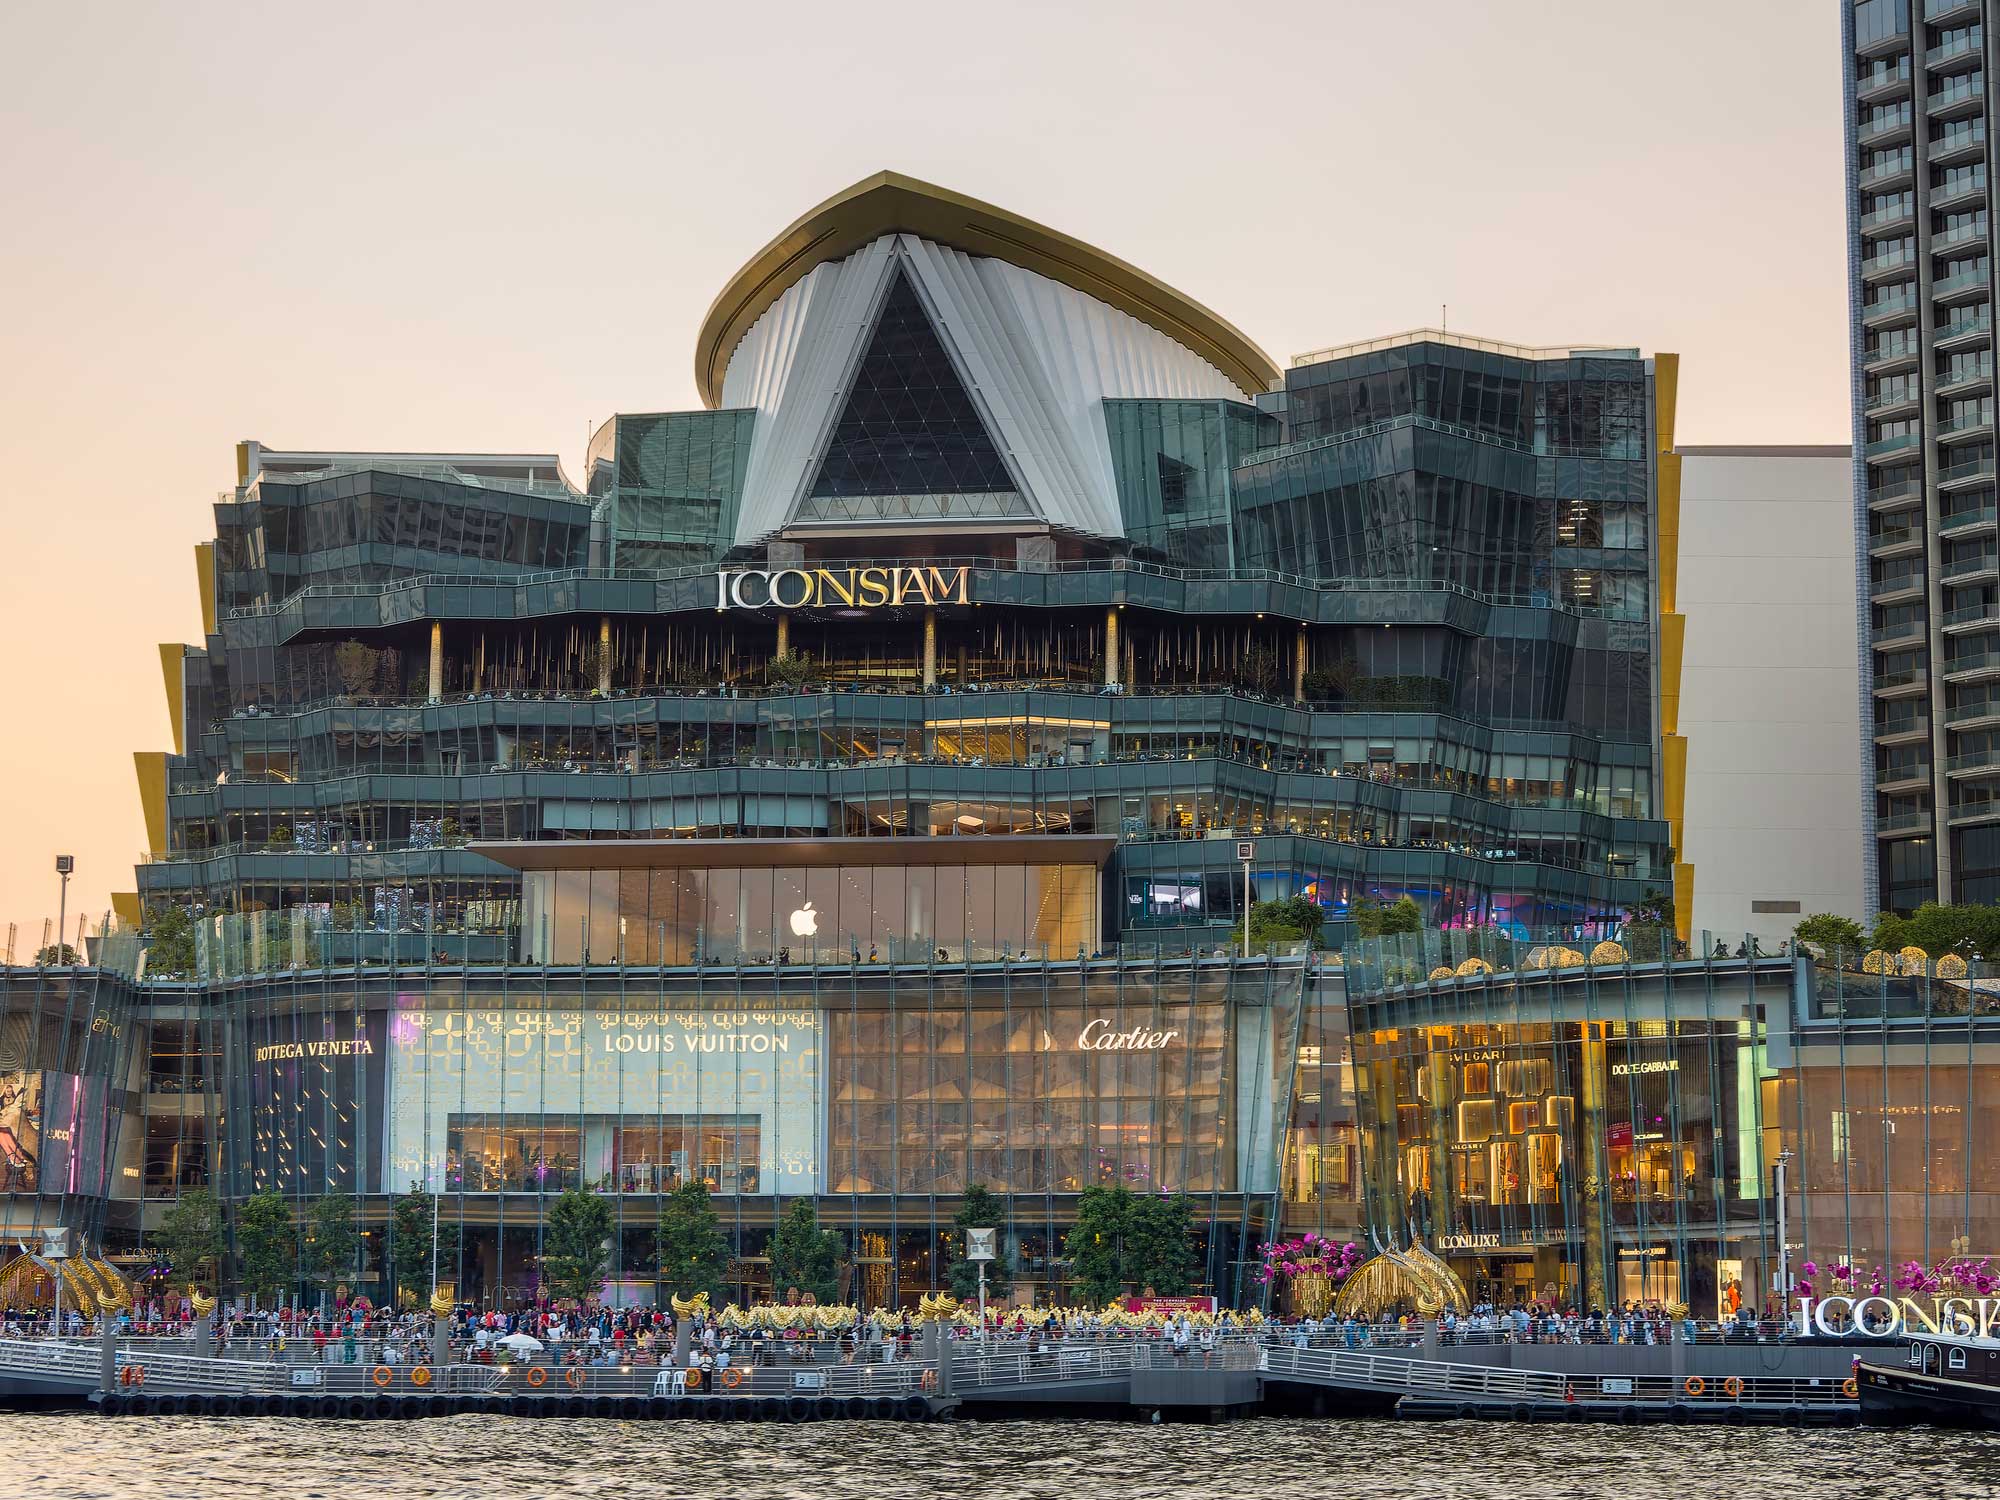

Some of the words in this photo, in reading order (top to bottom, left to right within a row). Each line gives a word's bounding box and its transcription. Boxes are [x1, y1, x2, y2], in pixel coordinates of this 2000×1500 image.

[715, 566, 972, 610] ICONSIAM
[605, 1034, 675, 1053] LOUIS
[684, 1033, 789, 1053] VUITTON
[1078, 1018, 1179, 1051] Cartier
[307, 1040, 374, 1057] VENETA
[295, 1374, 302, 1382] 2
[799, 1377, 805, 1385] 2
[1606, 1383, 1612, 1391] 3
